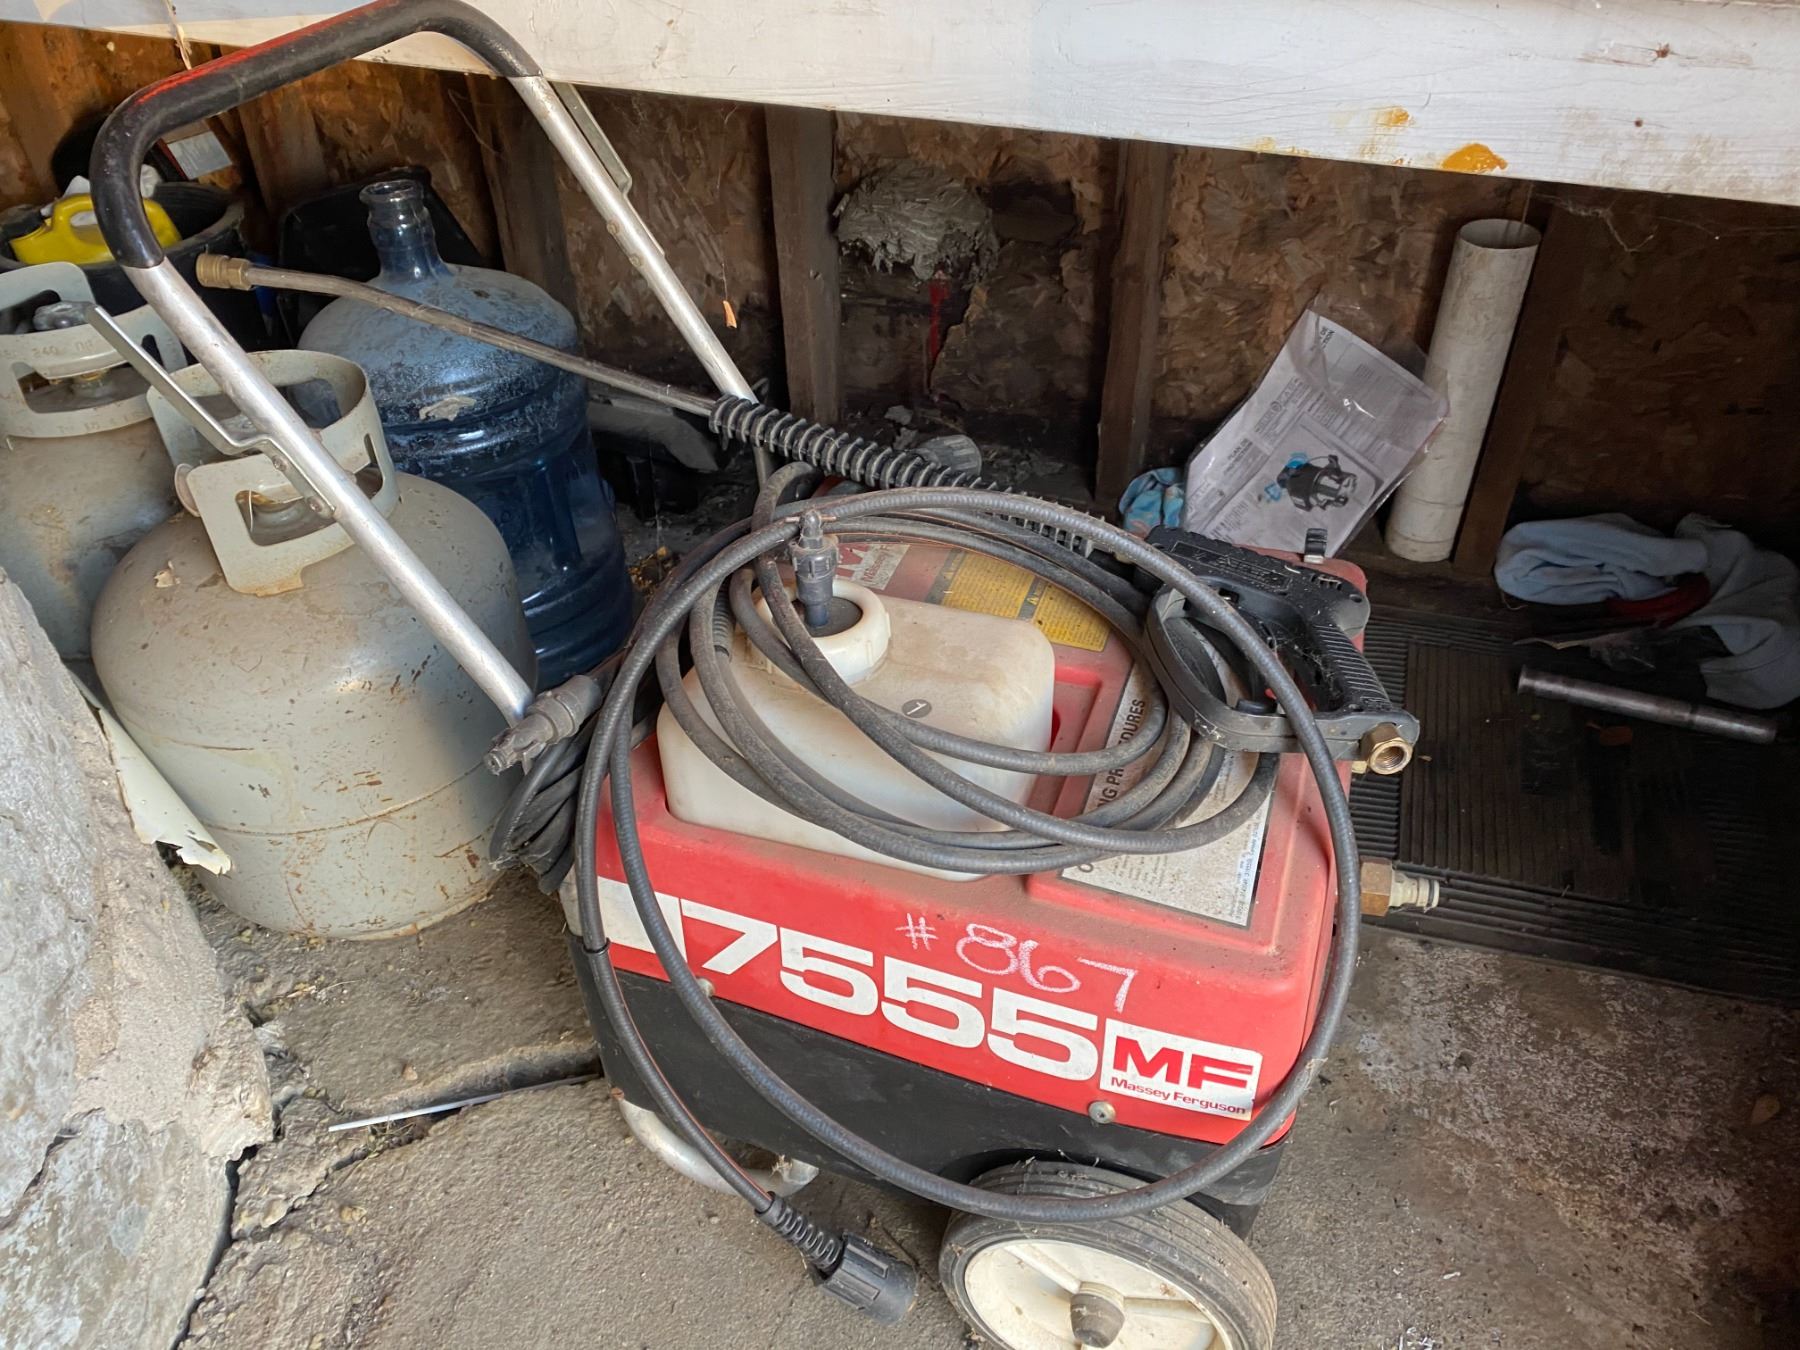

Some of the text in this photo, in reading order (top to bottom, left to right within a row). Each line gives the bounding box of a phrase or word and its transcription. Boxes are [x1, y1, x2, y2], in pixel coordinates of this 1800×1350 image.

[680, 898, 1099, 1081] 7555
[1113, 1035, 1254, 1090] MF
[1110, 1077, 1247, 1115] Massey Ferguson
